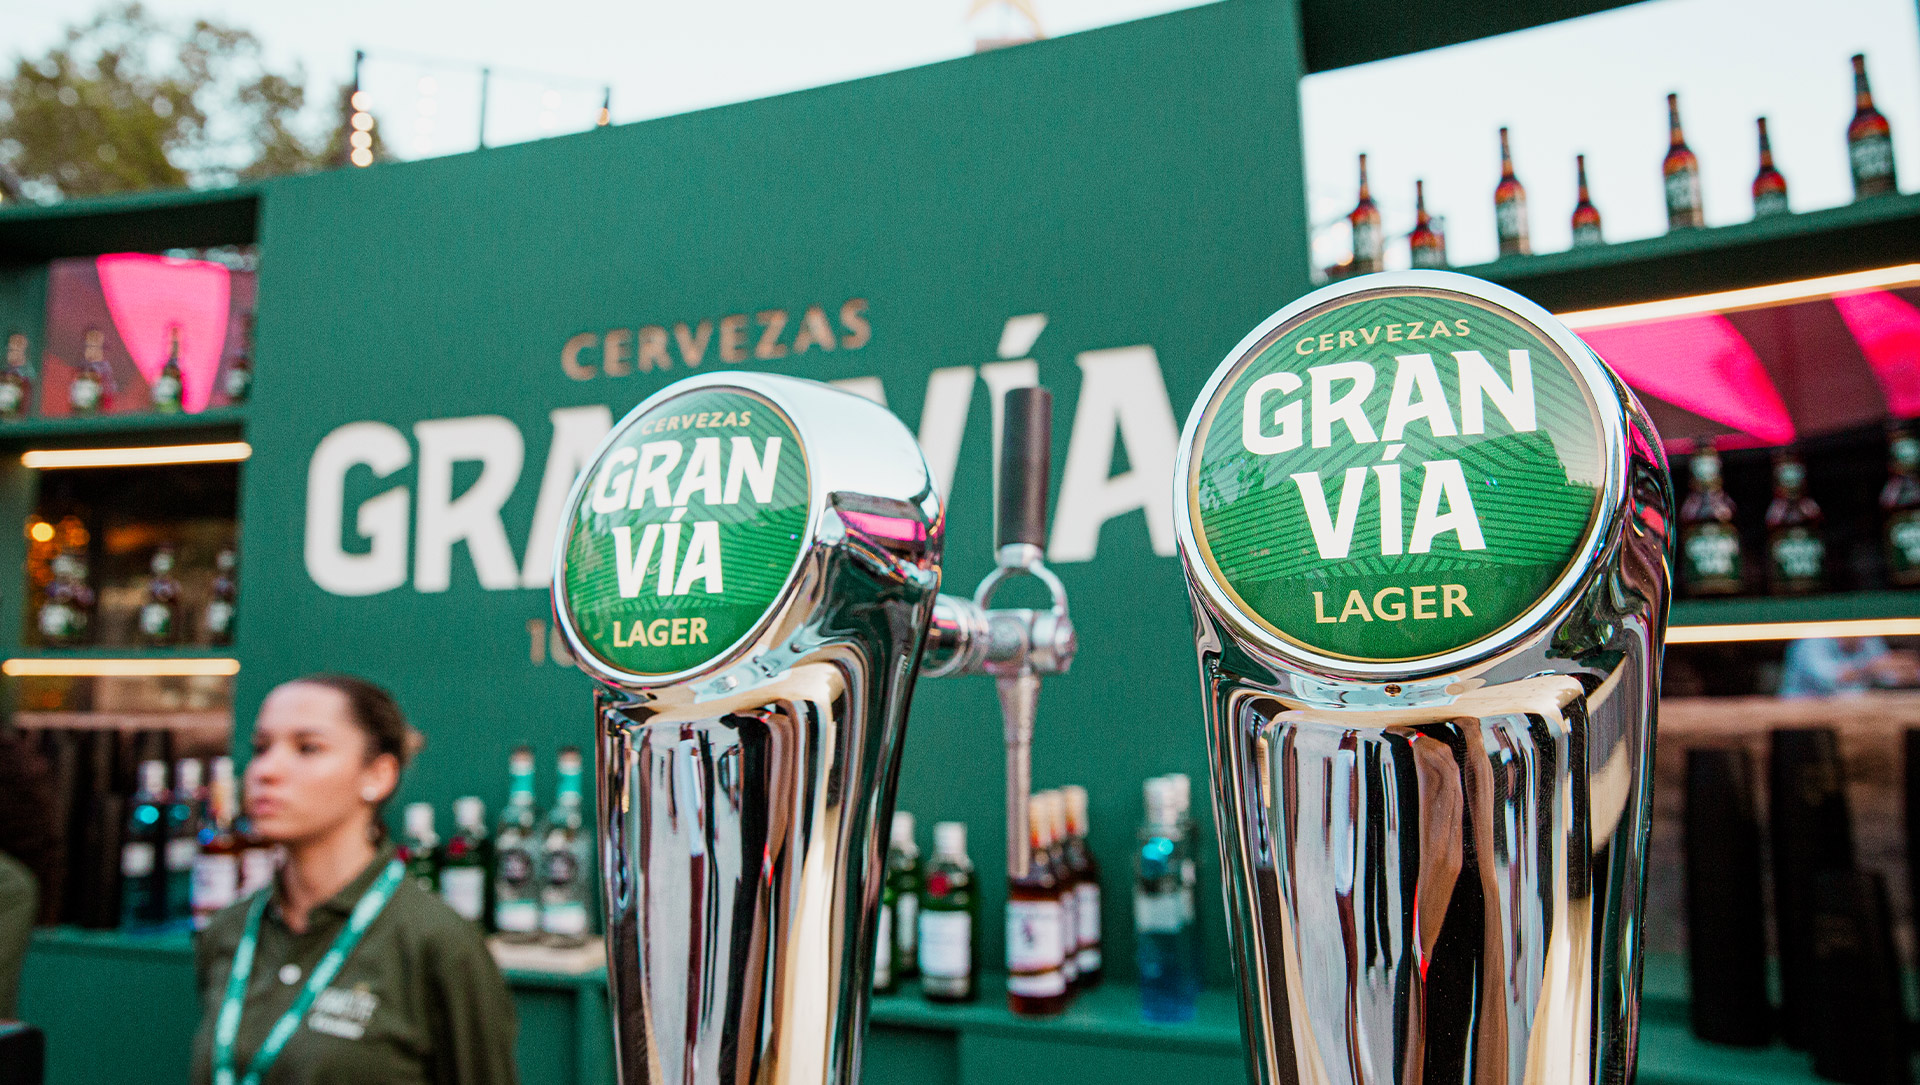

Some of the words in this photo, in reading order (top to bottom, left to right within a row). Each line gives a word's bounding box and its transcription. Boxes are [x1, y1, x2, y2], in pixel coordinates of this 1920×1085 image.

[561, 298, 871, 381] CERVEZAS
[1295, 318, 1471, 356] CERVEZAS
[641, 411, 752, 435] CERVEZAS
[1242, 349, 1538, 455] GRAN
[591, 436, 782, 514] GRAN
[1290, 443, 1486, 559] VÍA
[612, 507, 723, 598] VÍA
[613, 617, 709, 648] LAGER
[1312, 583, 1474, 624] LAGER
